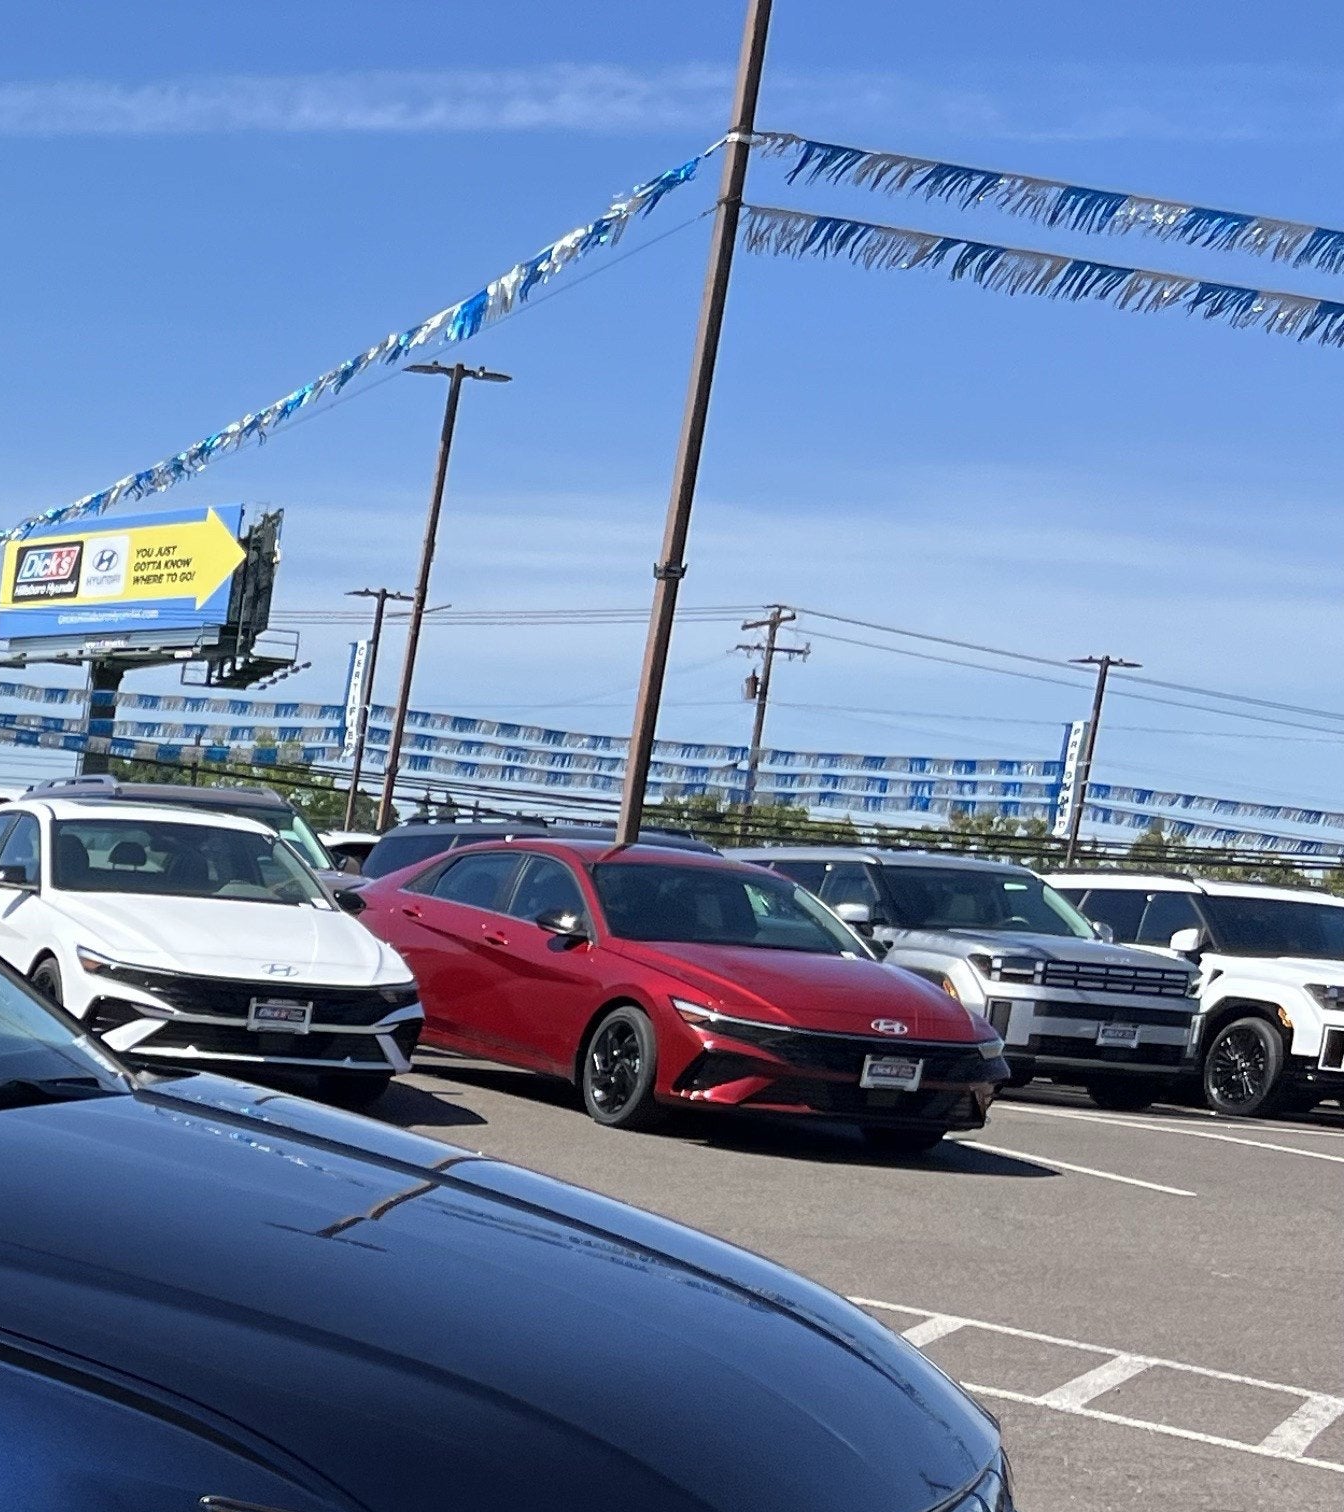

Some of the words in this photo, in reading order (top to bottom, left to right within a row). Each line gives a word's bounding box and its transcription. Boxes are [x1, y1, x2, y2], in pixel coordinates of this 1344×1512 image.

[136, 548, 154, 558] YOU
[155, 545, 177, 557] JUST
[21, 550, 74, 579] Dick's
[133, 560, 162, 571] GOTTA
[164, 557, 192, 569] KNOW
[132, 573, 164, 585] WHERE
[166, 572, 177, 582] TO
[179, 571, 196, 582] GO!
